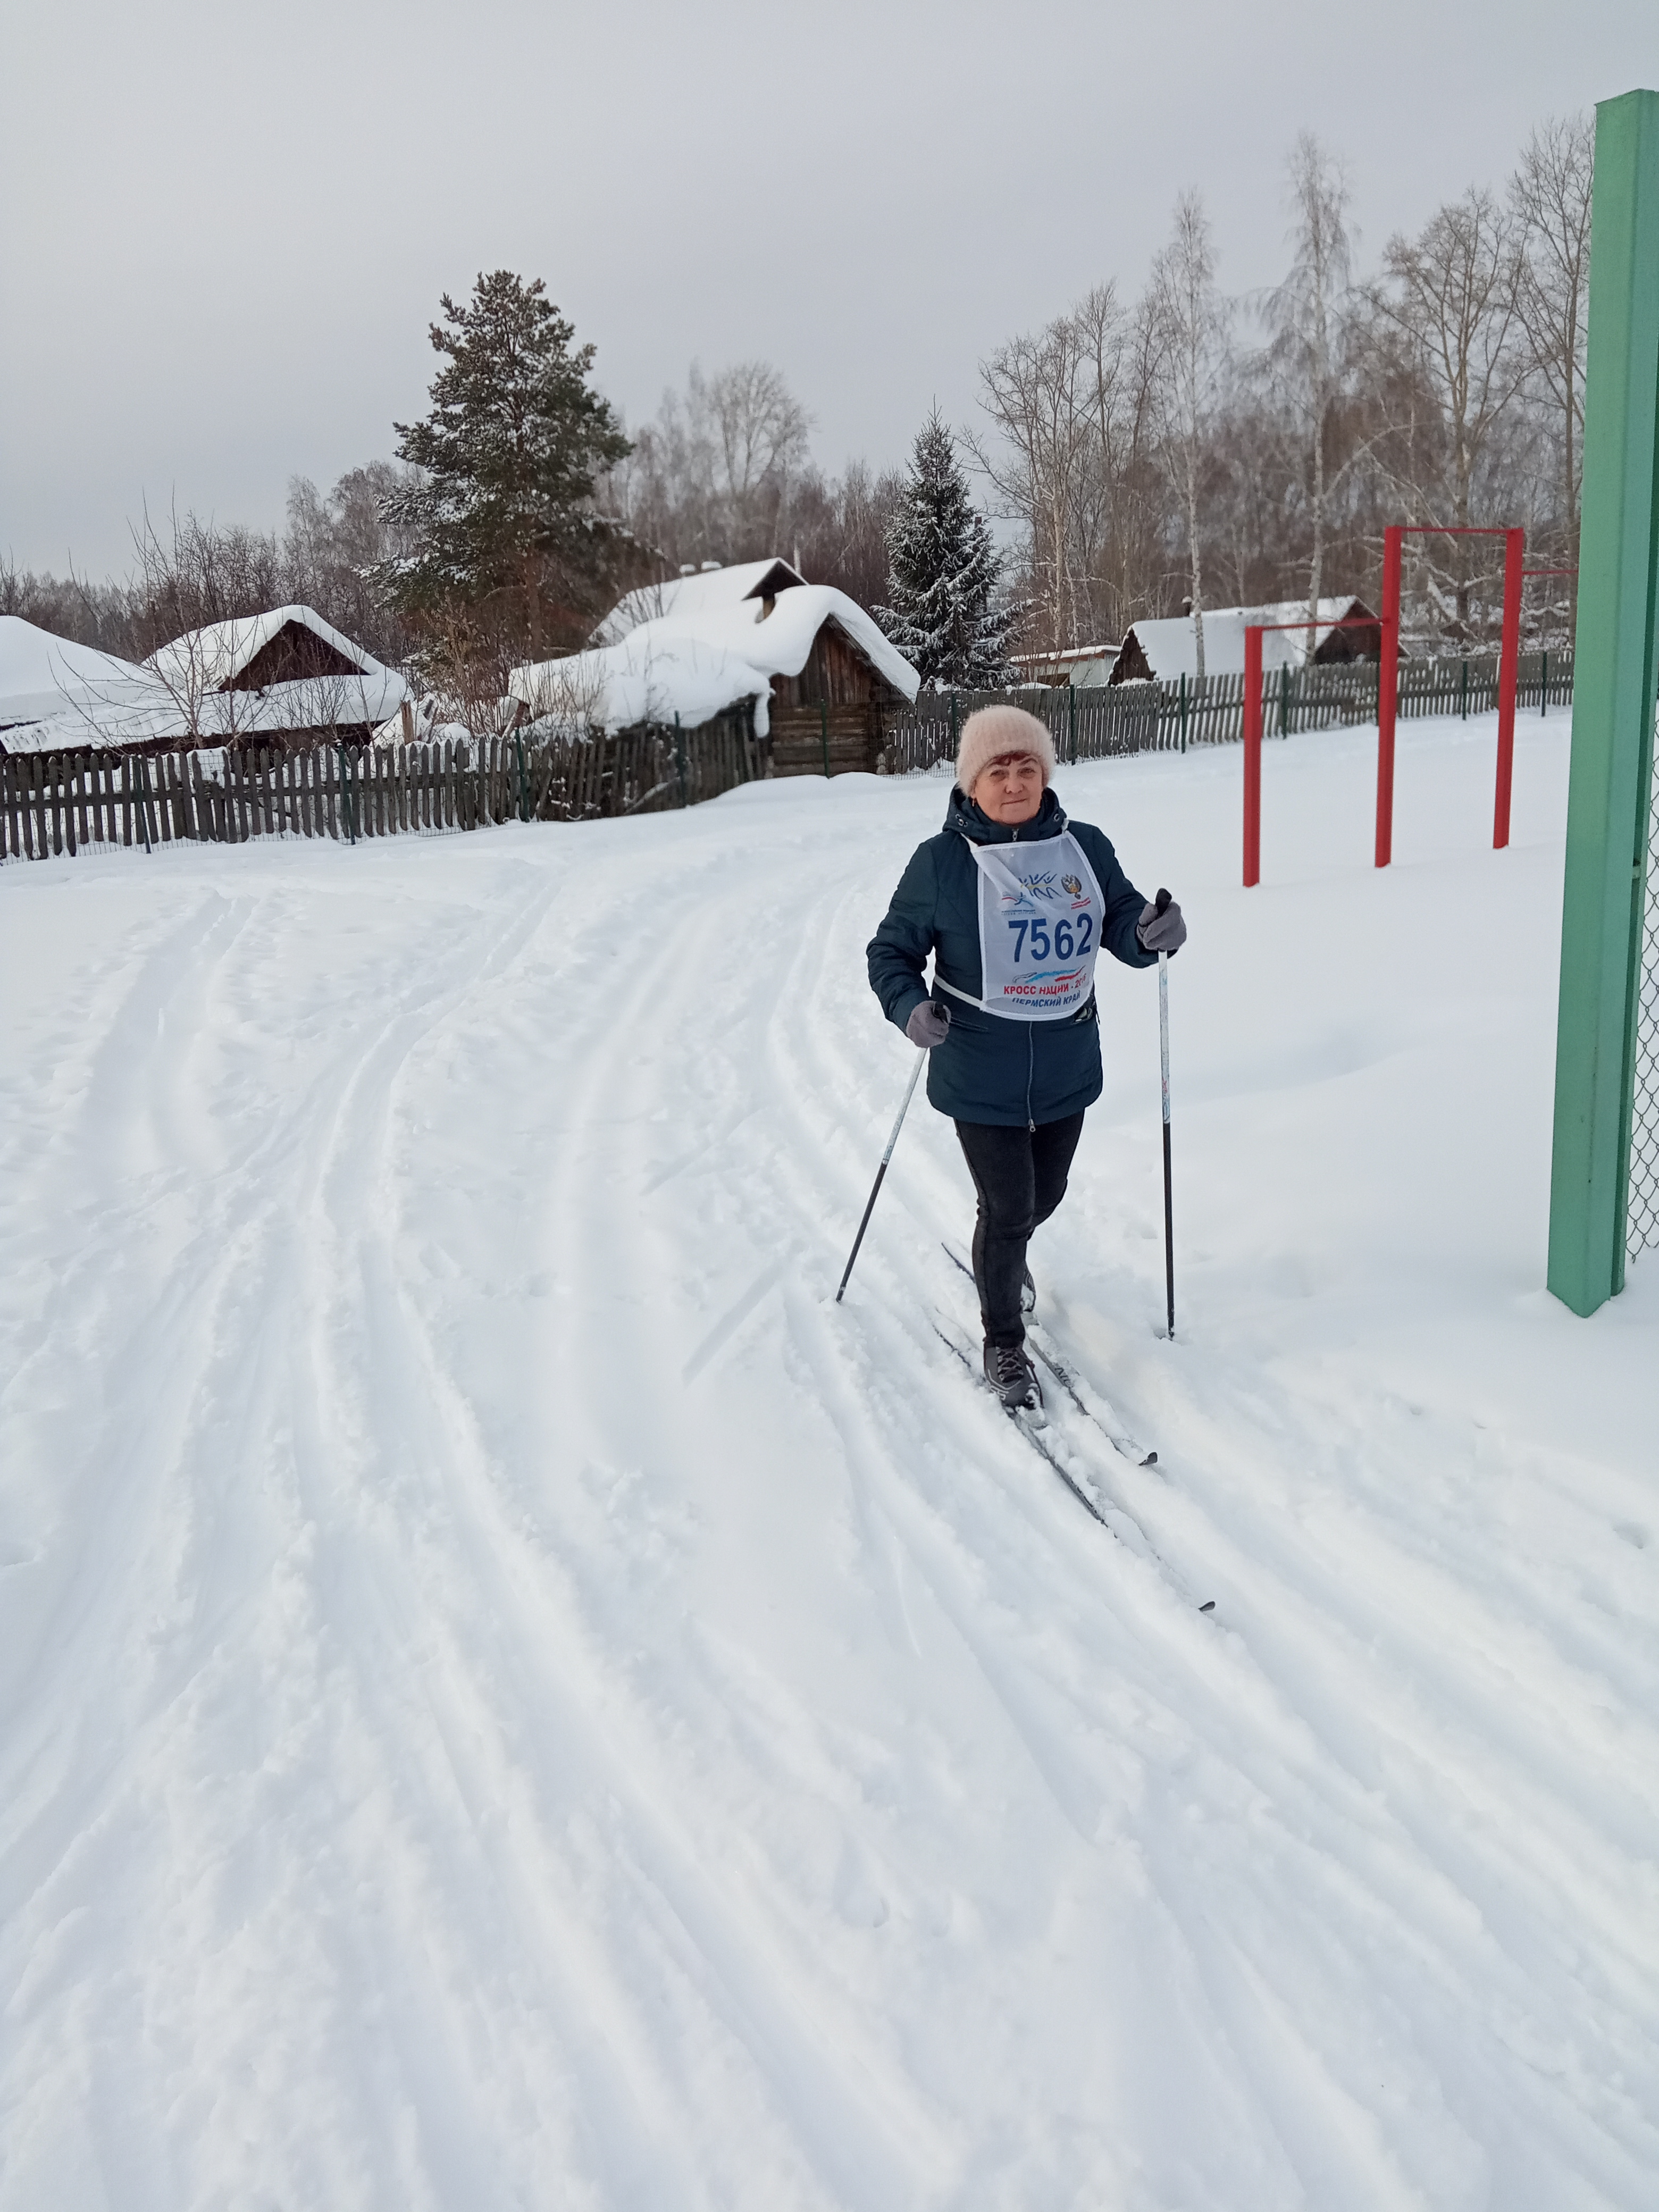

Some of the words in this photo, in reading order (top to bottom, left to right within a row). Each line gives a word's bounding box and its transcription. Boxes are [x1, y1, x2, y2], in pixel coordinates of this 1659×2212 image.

[1008, 913, 1093, 962] 7562
[1003, 985, 1036, 995] КРОСС
[1039, 983, 1069, 995] НАЦИИ
[1012, 996, 1061, 1007] ПЕРМСКИЙ
[1063, 990, 1080, 1004] КРАЙ
